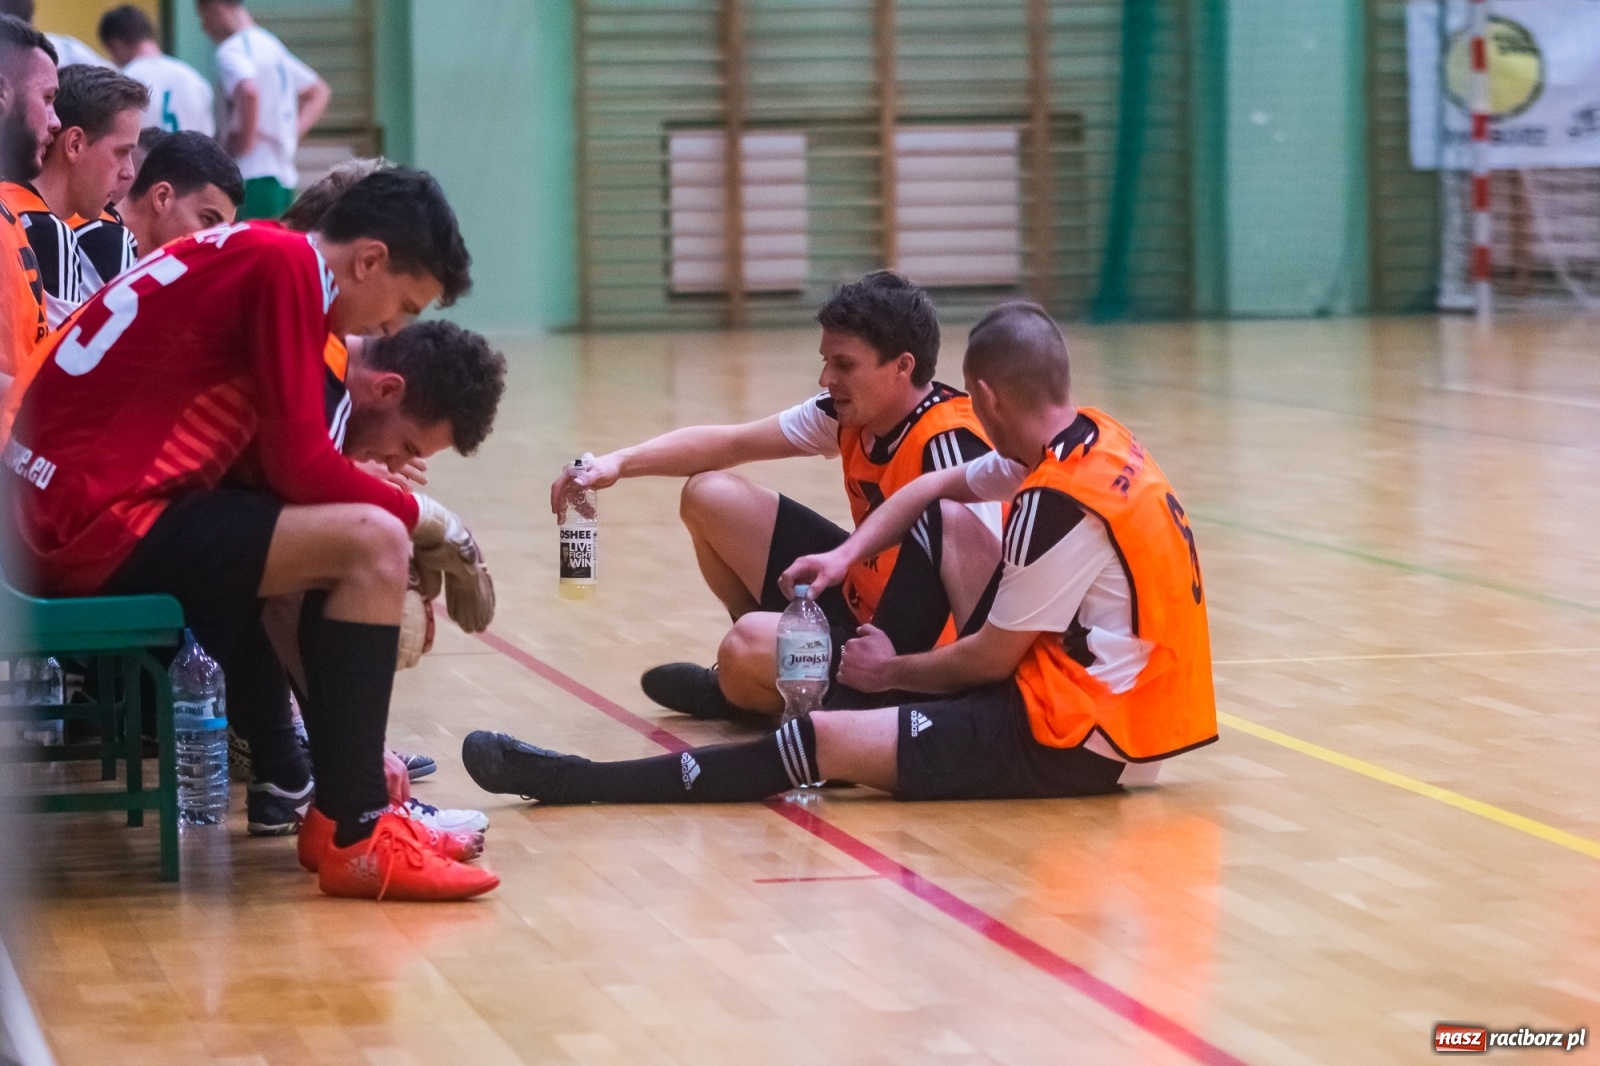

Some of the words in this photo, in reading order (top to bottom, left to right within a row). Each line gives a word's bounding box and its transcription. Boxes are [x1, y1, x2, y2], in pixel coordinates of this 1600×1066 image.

[569, 542, 591, 552] LIVE
[910, 710, 918, 737] adidas
[681, 752, 692, 791] adidas
